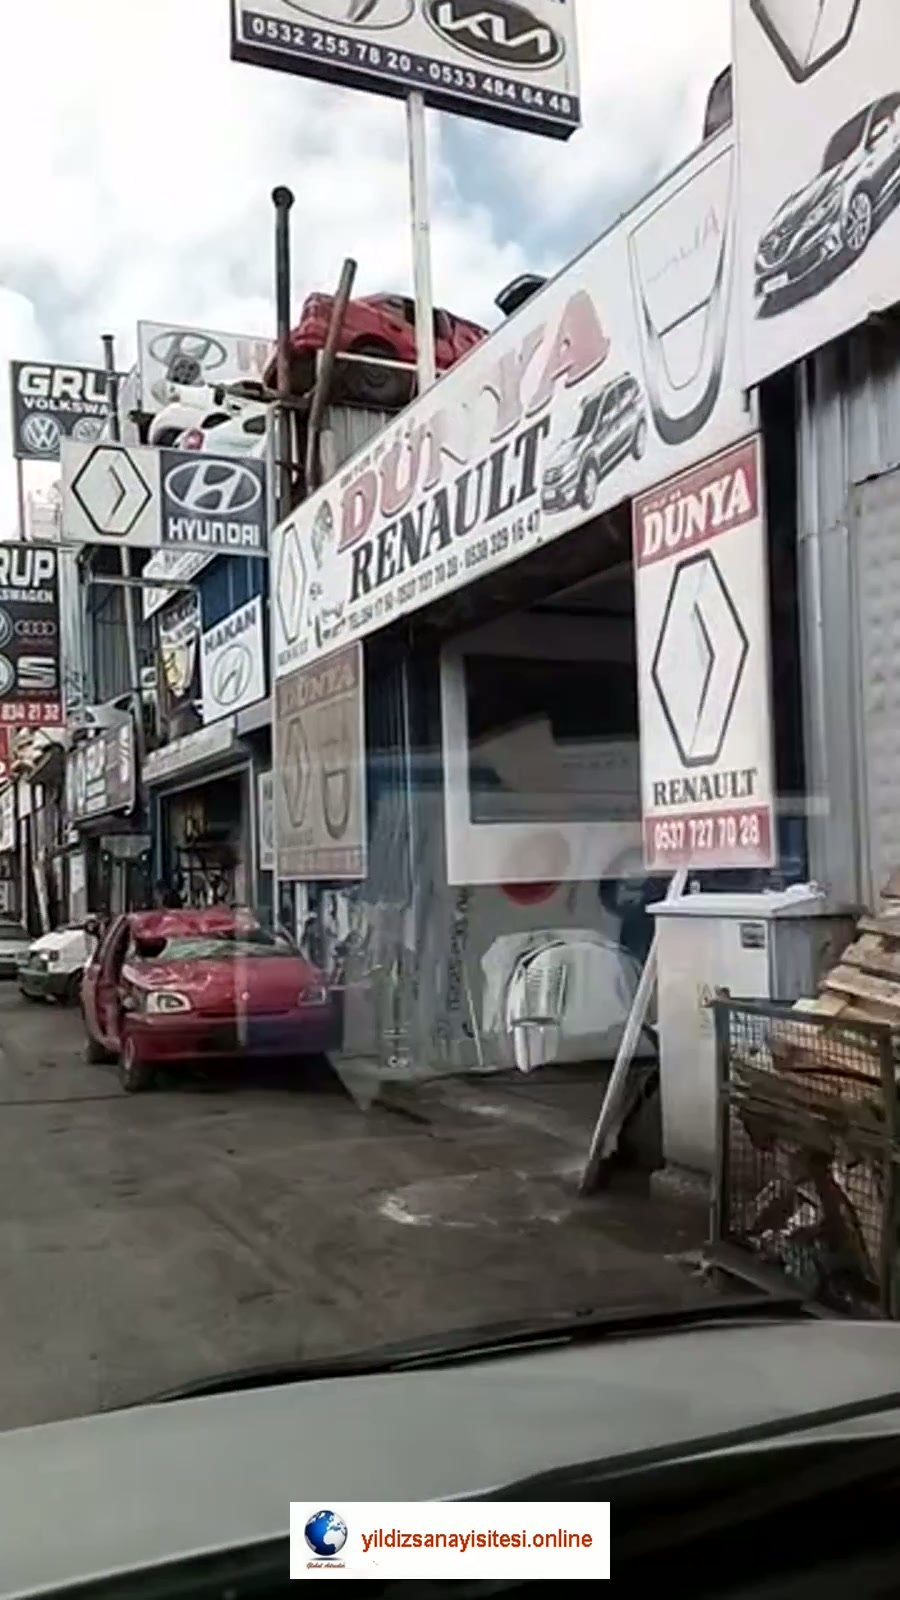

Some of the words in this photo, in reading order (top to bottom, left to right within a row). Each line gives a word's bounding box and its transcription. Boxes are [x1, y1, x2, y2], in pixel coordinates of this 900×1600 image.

[252, 17, 305, 46] 0532
[311, 33, 350, 57] 255
[356, 44, 381, 64] 78
[387, 52, 411, 72] 20
[429, 63, 476, 89] 0533
[482, 78, 517, 99] 484
[548, 95, 571, 114] 48
[168, 517, 260, 547] HYUNDAI
[349, 414, 551, 604] RENAULT
[642, 467, 753, 557] DÜNYA
[203, 604, 257, 657] HAKAN
[653, 766, 758, 807] RENAULT
[688, 818, 714, 849] 727
[716, 815, 737, 849] 70
